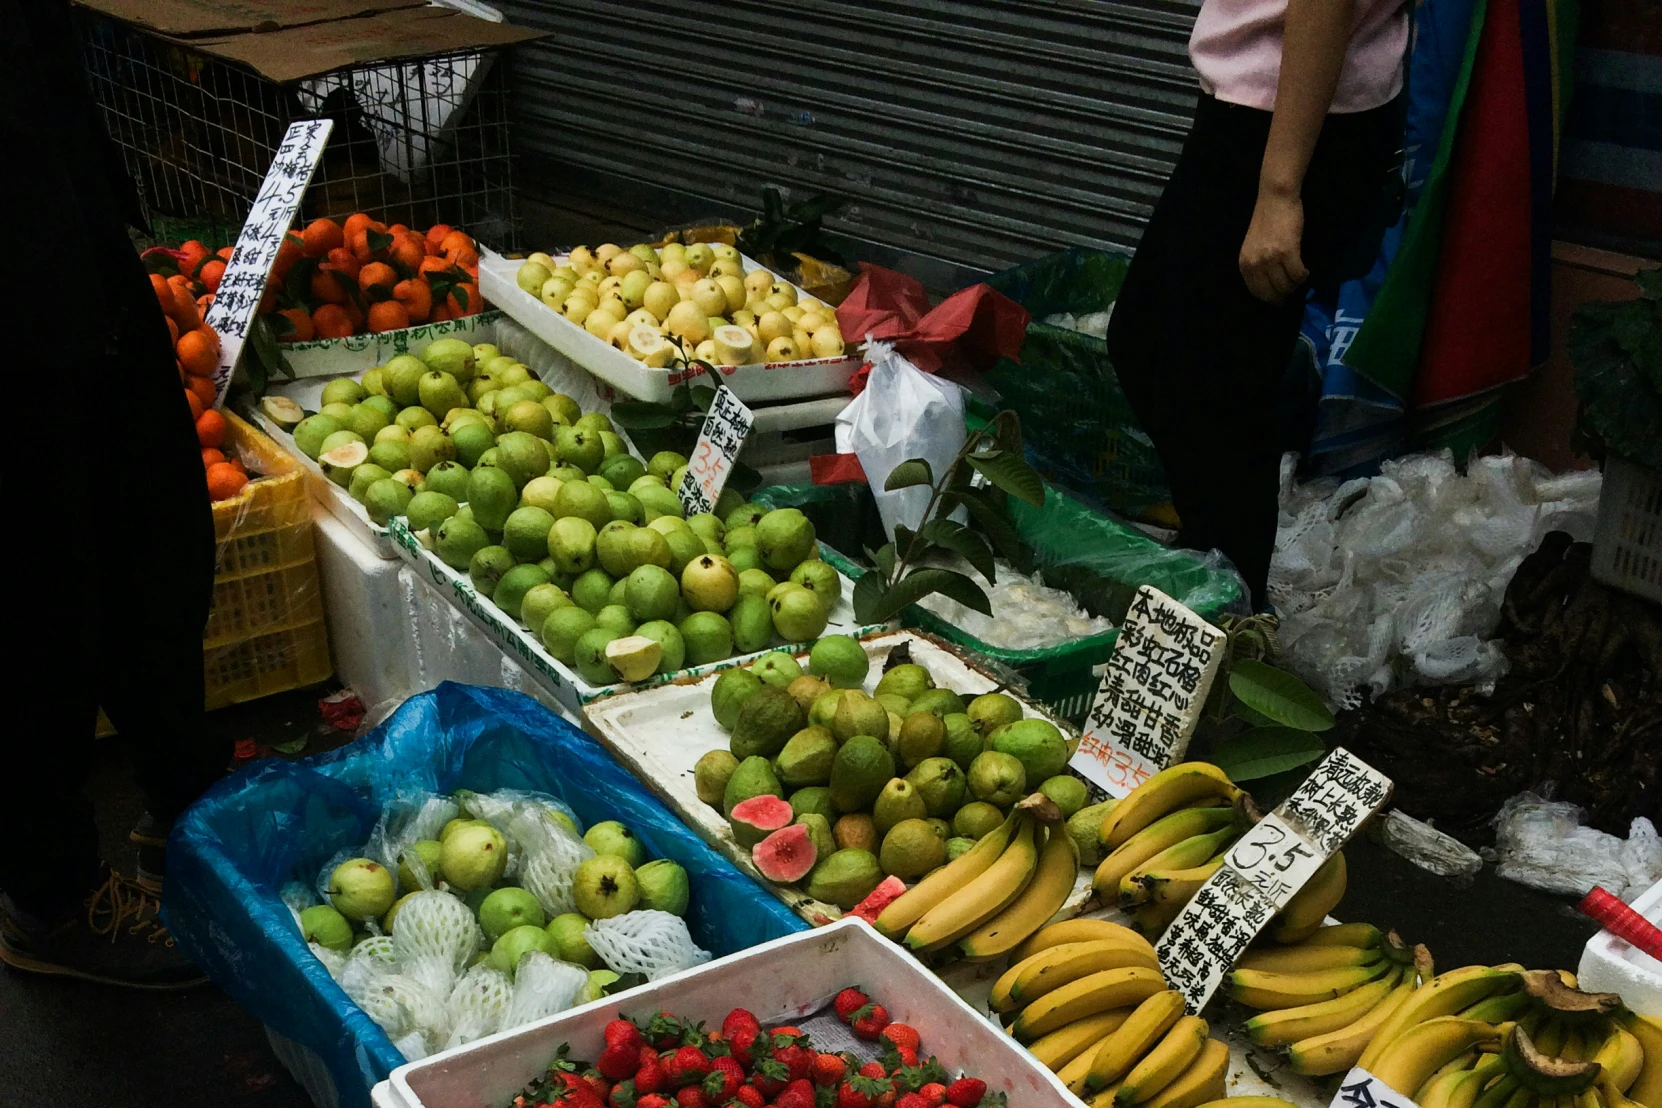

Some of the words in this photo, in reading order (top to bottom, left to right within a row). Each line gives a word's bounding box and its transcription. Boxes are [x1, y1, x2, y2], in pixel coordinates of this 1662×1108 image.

[257, 180, 304, 213] 4.5
[694, 441, 724, 475] 3.5
[1120, 618, 1201, 695] 彩虹石榴
[1131, 588, 1215, 665] 本地极品
[1099, 669, 1183, 748] 清甜甘香
[1108, 645, 1189, 711] 红肉红心
[1300, 773, 1358, 833] 树上长熟
[1232, 823, 1314, 872] 3.5
[1167, 923, 1213, 982] 营养超高
[1195, 887, 1251, 956] 鲜甜香滑
